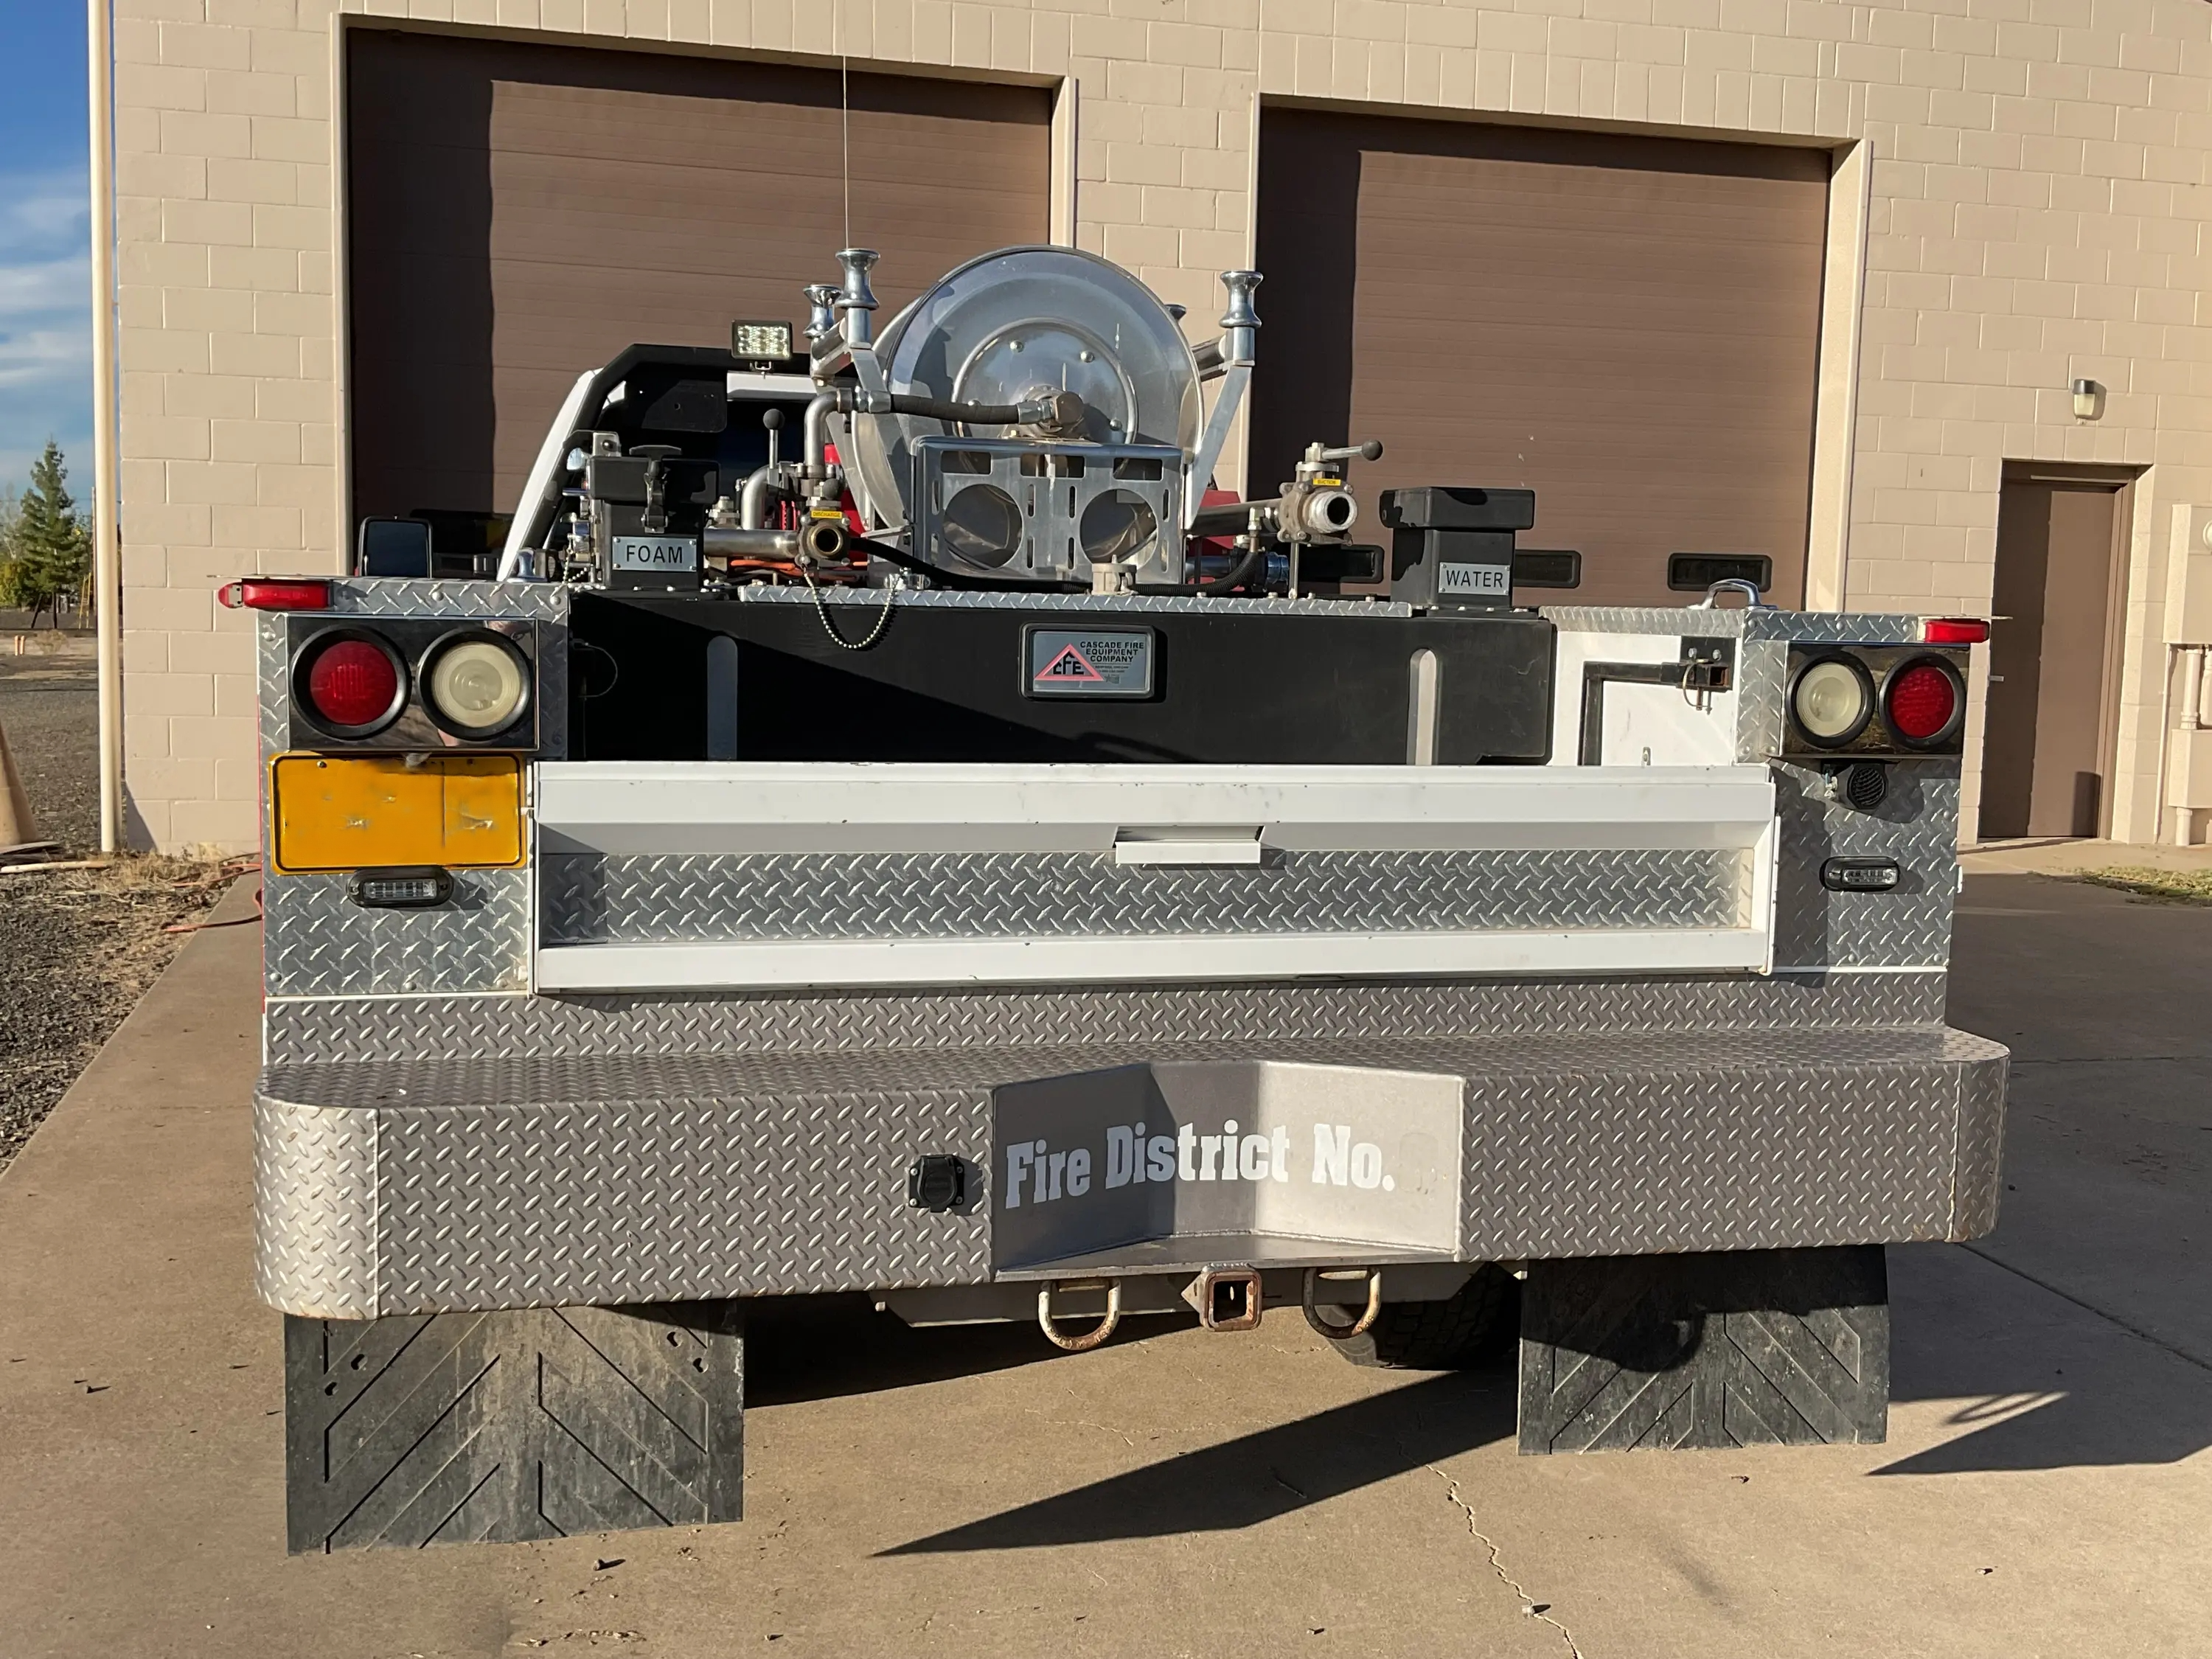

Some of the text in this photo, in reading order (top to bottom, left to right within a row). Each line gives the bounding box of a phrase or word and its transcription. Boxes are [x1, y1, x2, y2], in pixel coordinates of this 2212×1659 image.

[627, 545, 683, 563] FOAM
[1447, 570, 1503, 588] WATER
[1006, 1119, 1396, 1209] Fire District No.
